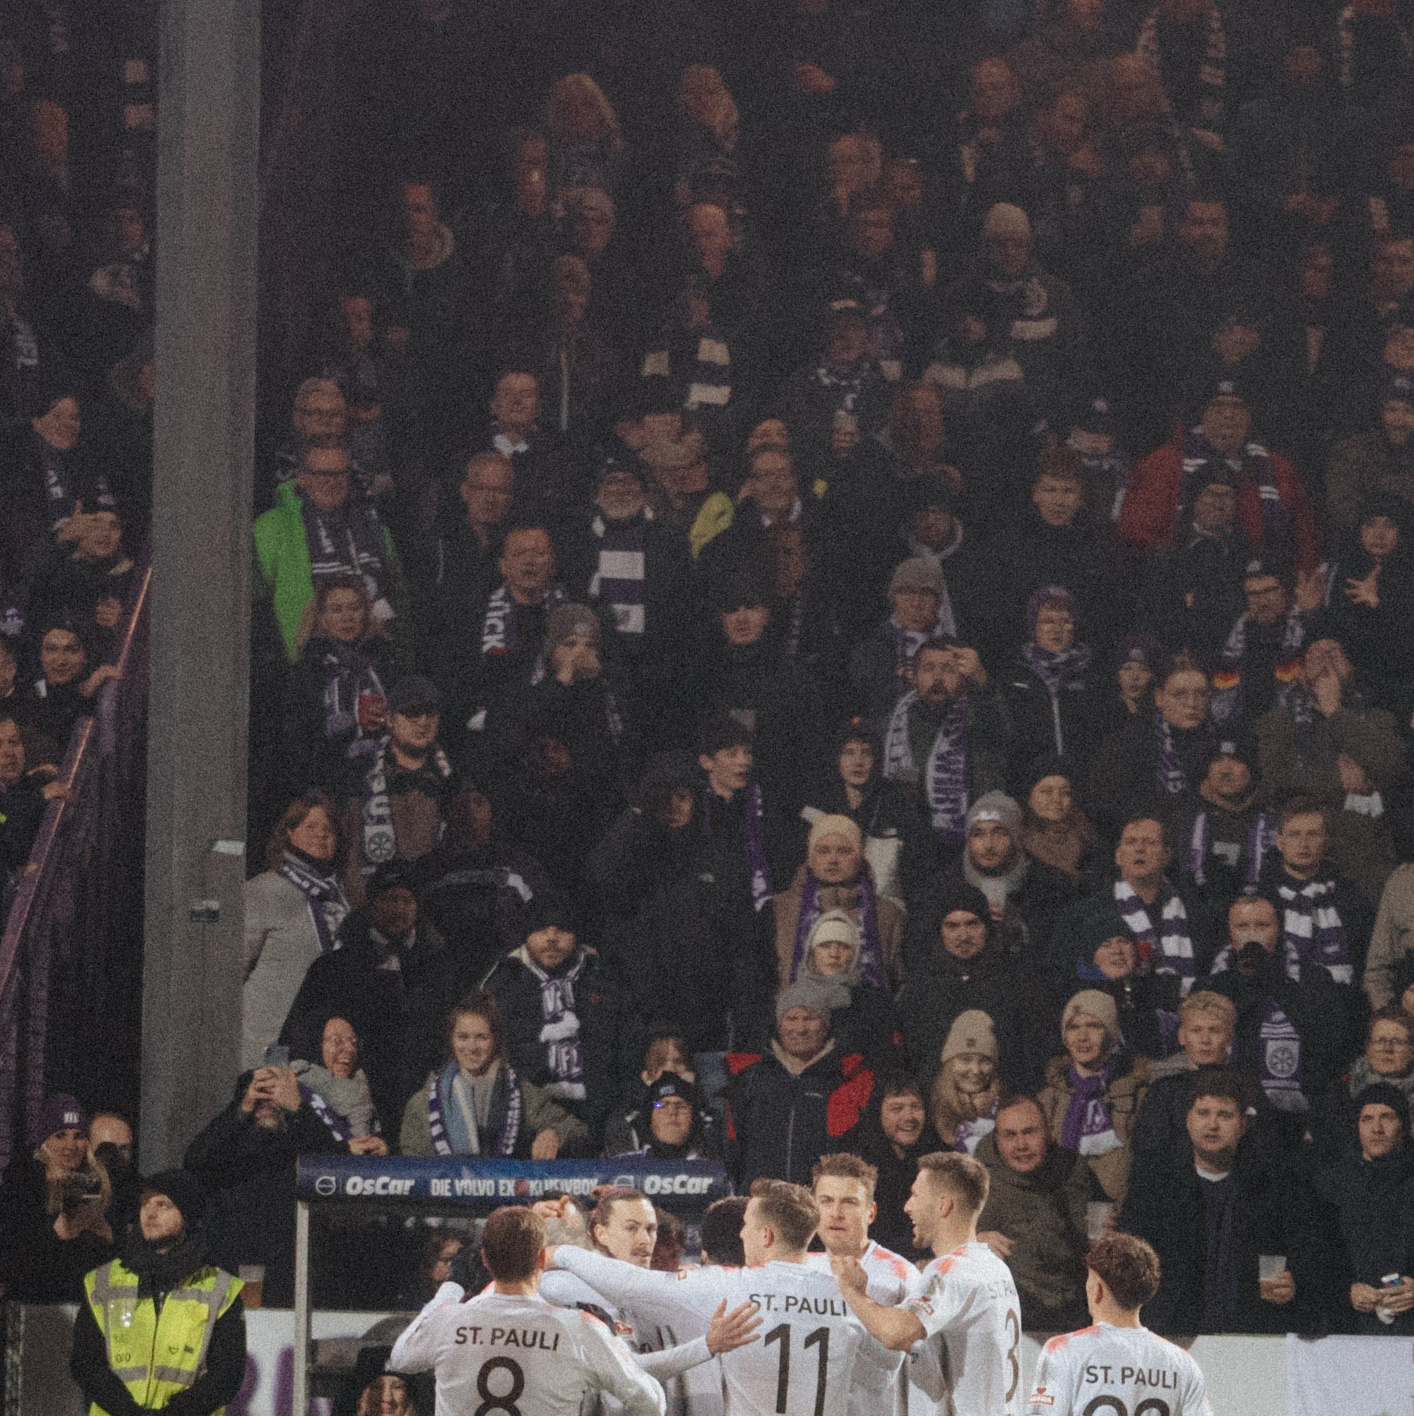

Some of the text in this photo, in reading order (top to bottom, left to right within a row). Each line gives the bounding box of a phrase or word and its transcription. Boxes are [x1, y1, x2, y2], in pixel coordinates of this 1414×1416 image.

[345, 1176, 416, 1196] OsCar
[431, 1178, 452, 1196] DIE
[455, 1178, 495, 1197] VOLVO
[643, 1175, 714, 1196] OsCar
[748, 1293, 848, 1317] ST. PAULI
[454, 1326, 561, 1351] ST. PAULI
[1085, 1365, 1178, 1390] ST. PAULI
